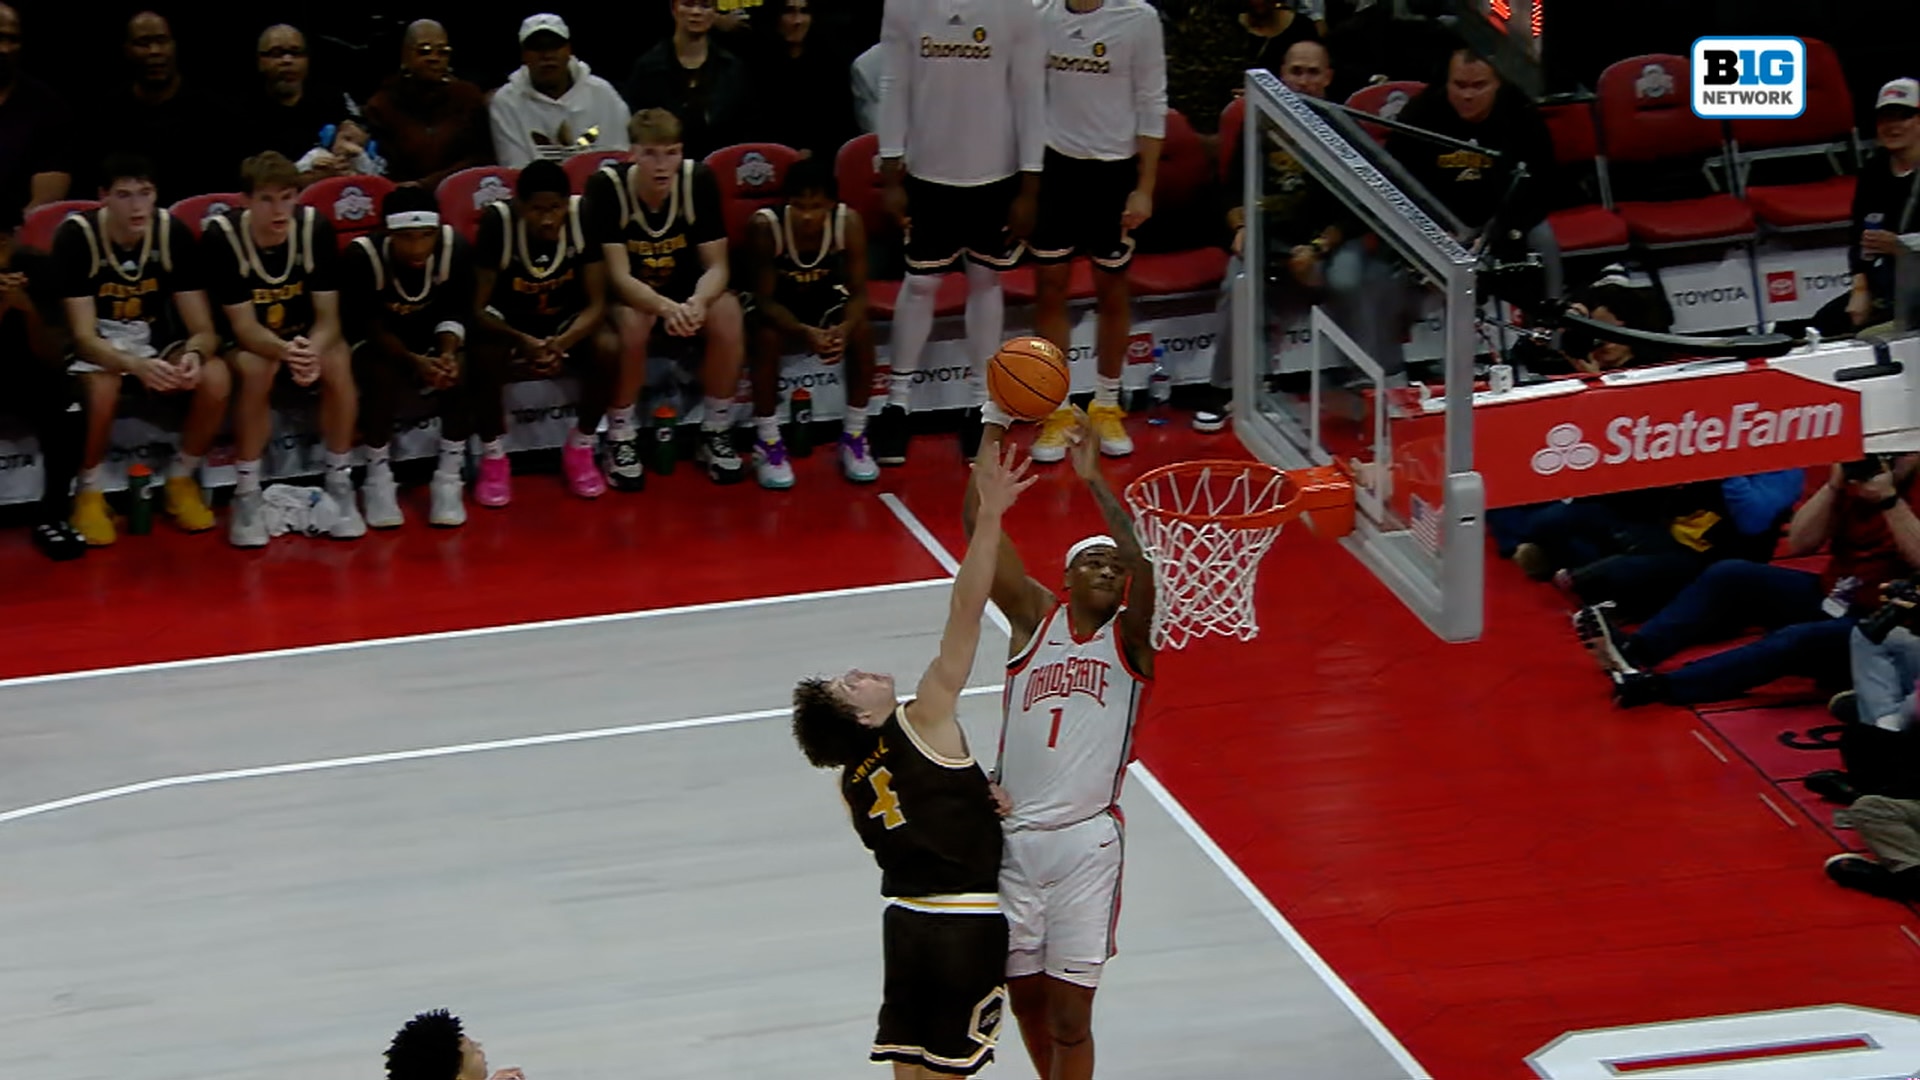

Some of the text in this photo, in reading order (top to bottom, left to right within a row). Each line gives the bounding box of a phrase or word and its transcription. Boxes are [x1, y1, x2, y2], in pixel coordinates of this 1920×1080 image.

[920, 36, 991, 58] Broncos
[1046, 54, 1110, 73] roncos
[1803, 272, 1852, 290] TOYO
[1673, 286, 1748, 306] TOYOTA
[1160, 334, 1217, 352] TOYO
[777, 372, 839, 391] OYOTA
[911, 366, 982, 384] OYOTA
[1047, 707, 1063, 748] 1
[868, 766, 907, 830] 4
